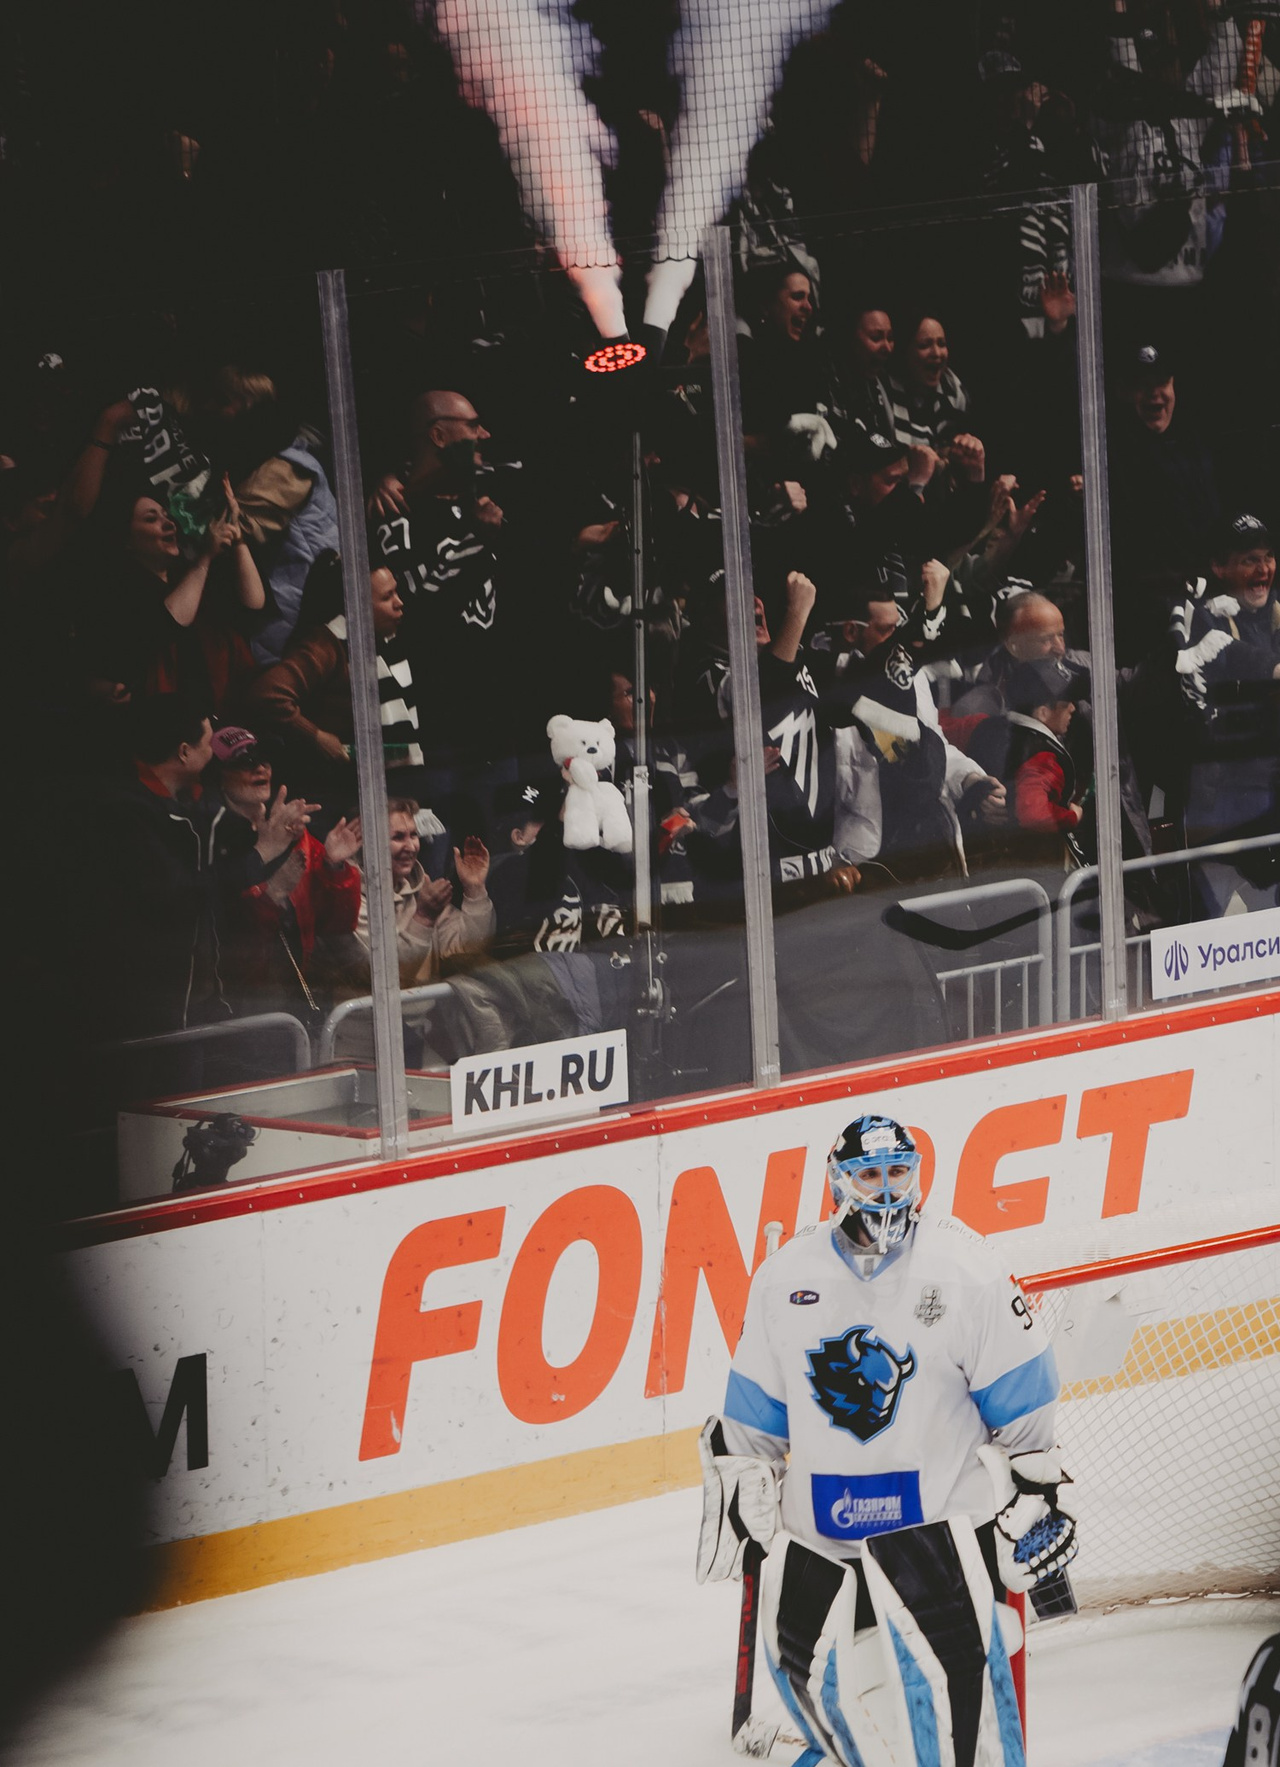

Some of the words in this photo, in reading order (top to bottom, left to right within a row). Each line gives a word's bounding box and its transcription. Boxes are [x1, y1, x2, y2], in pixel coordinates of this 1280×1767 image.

[377, 517, 412, 555] 27
[464, 1046, 616, 1116] KHL.RU
[1011, 1294, 1033, 1331] 9
[853, 1495, 902, 1512] ГАЗПРОМ
